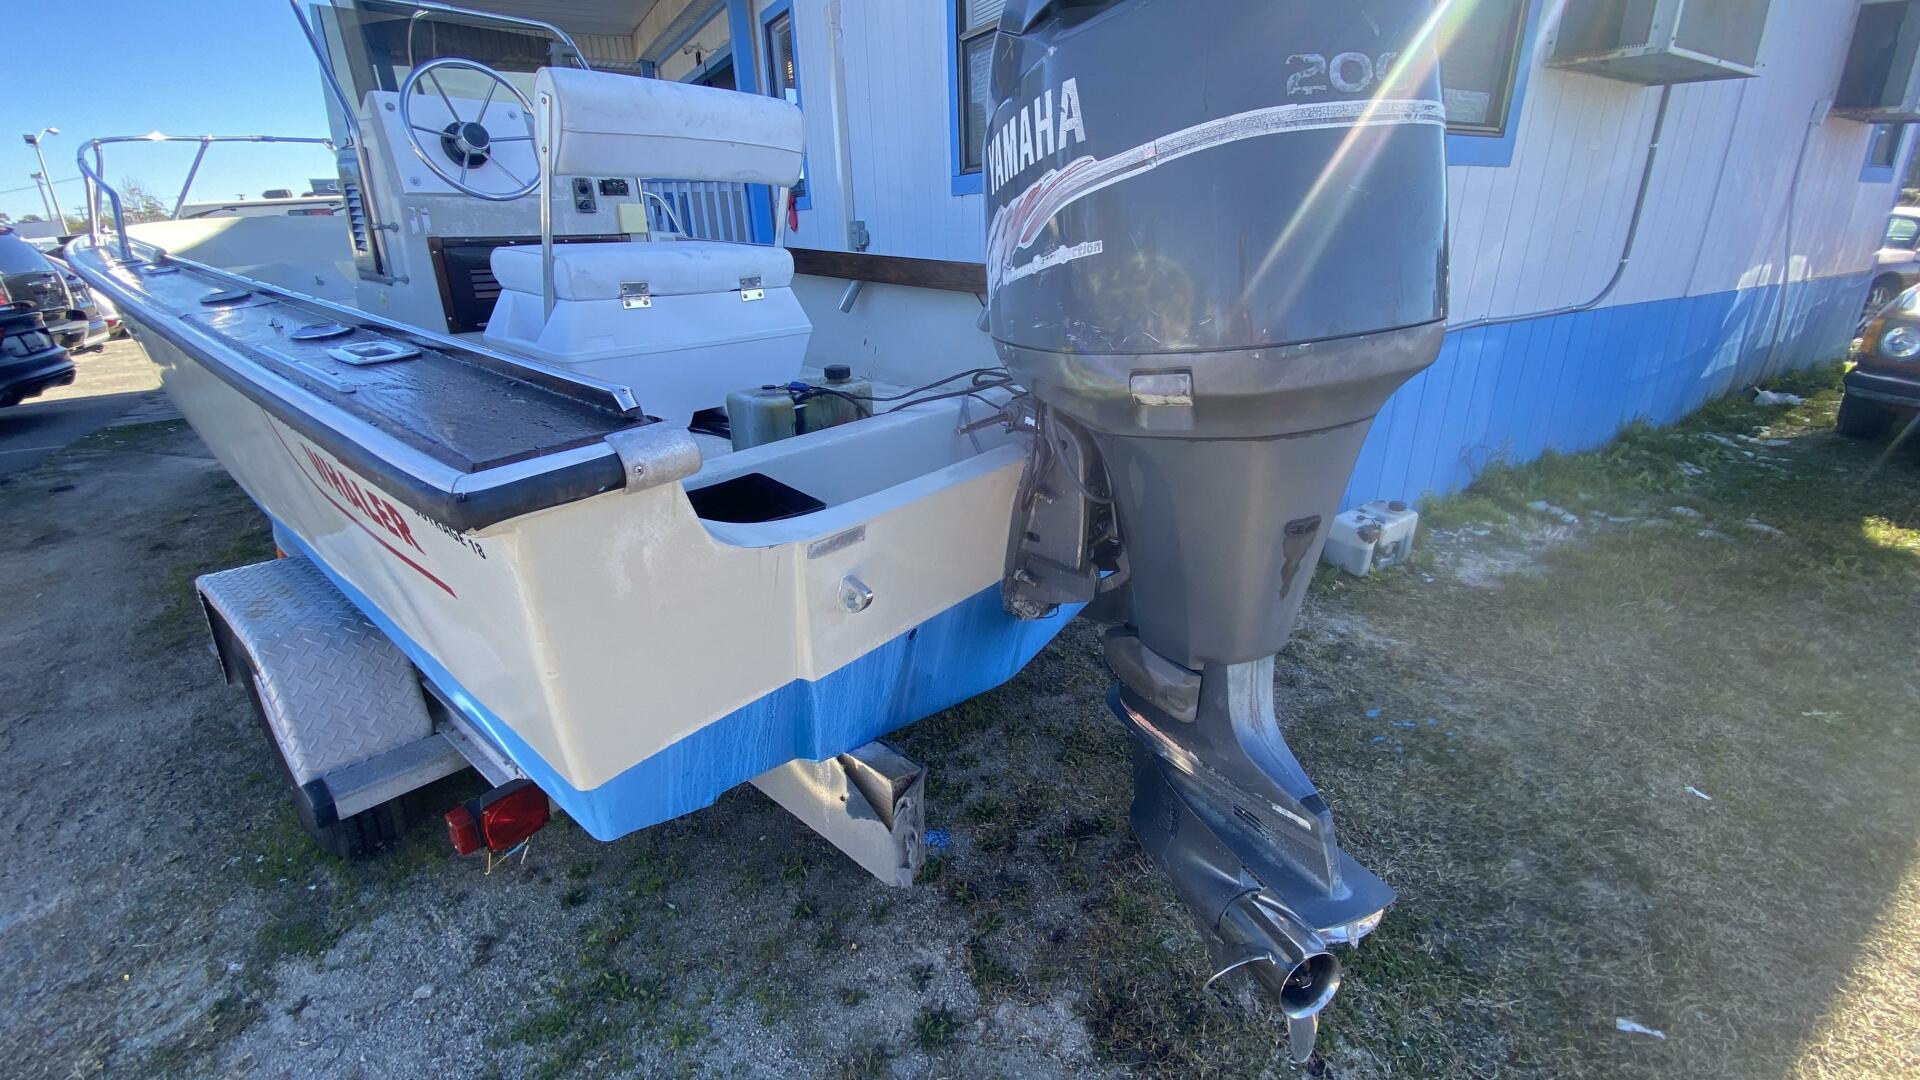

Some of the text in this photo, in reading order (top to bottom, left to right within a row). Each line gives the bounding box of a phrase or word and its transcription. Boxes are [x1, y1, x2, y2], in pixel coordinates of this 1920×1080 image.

[987, 77, 1087, 196] YAMAHA
[299, 441, 426, 555] WHALER
[468, 538, 487, 559] 18
